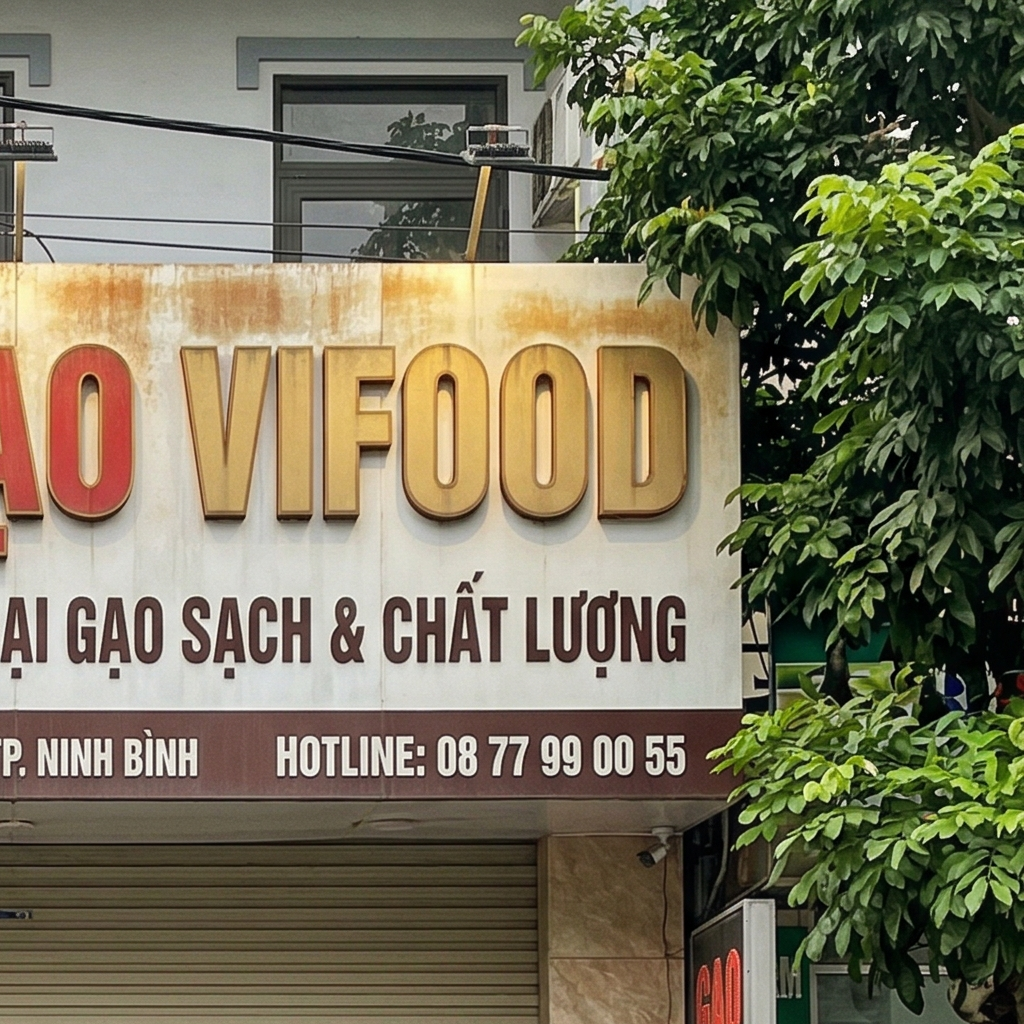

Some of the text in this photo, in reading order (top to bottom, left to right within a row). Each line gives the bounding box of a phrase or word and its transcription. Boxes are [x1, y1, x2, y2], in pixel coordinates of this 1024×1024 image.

[180, 343, 689, 523] VIFOOD
[66, 597, 164, 679] GẠO
[181, 597, 311, 679] SẠCH
[330, 597, 365, 665] &
[383, 571, 508, 664] CHẤT
[526, 590, 687, 679] LƯỢNG
[37, 738, 113, 777] NINH
[124, 729, 198, 777] BÌNH
[276, 735, 686, 777] HOTLINE: 08 77 99 00 55
